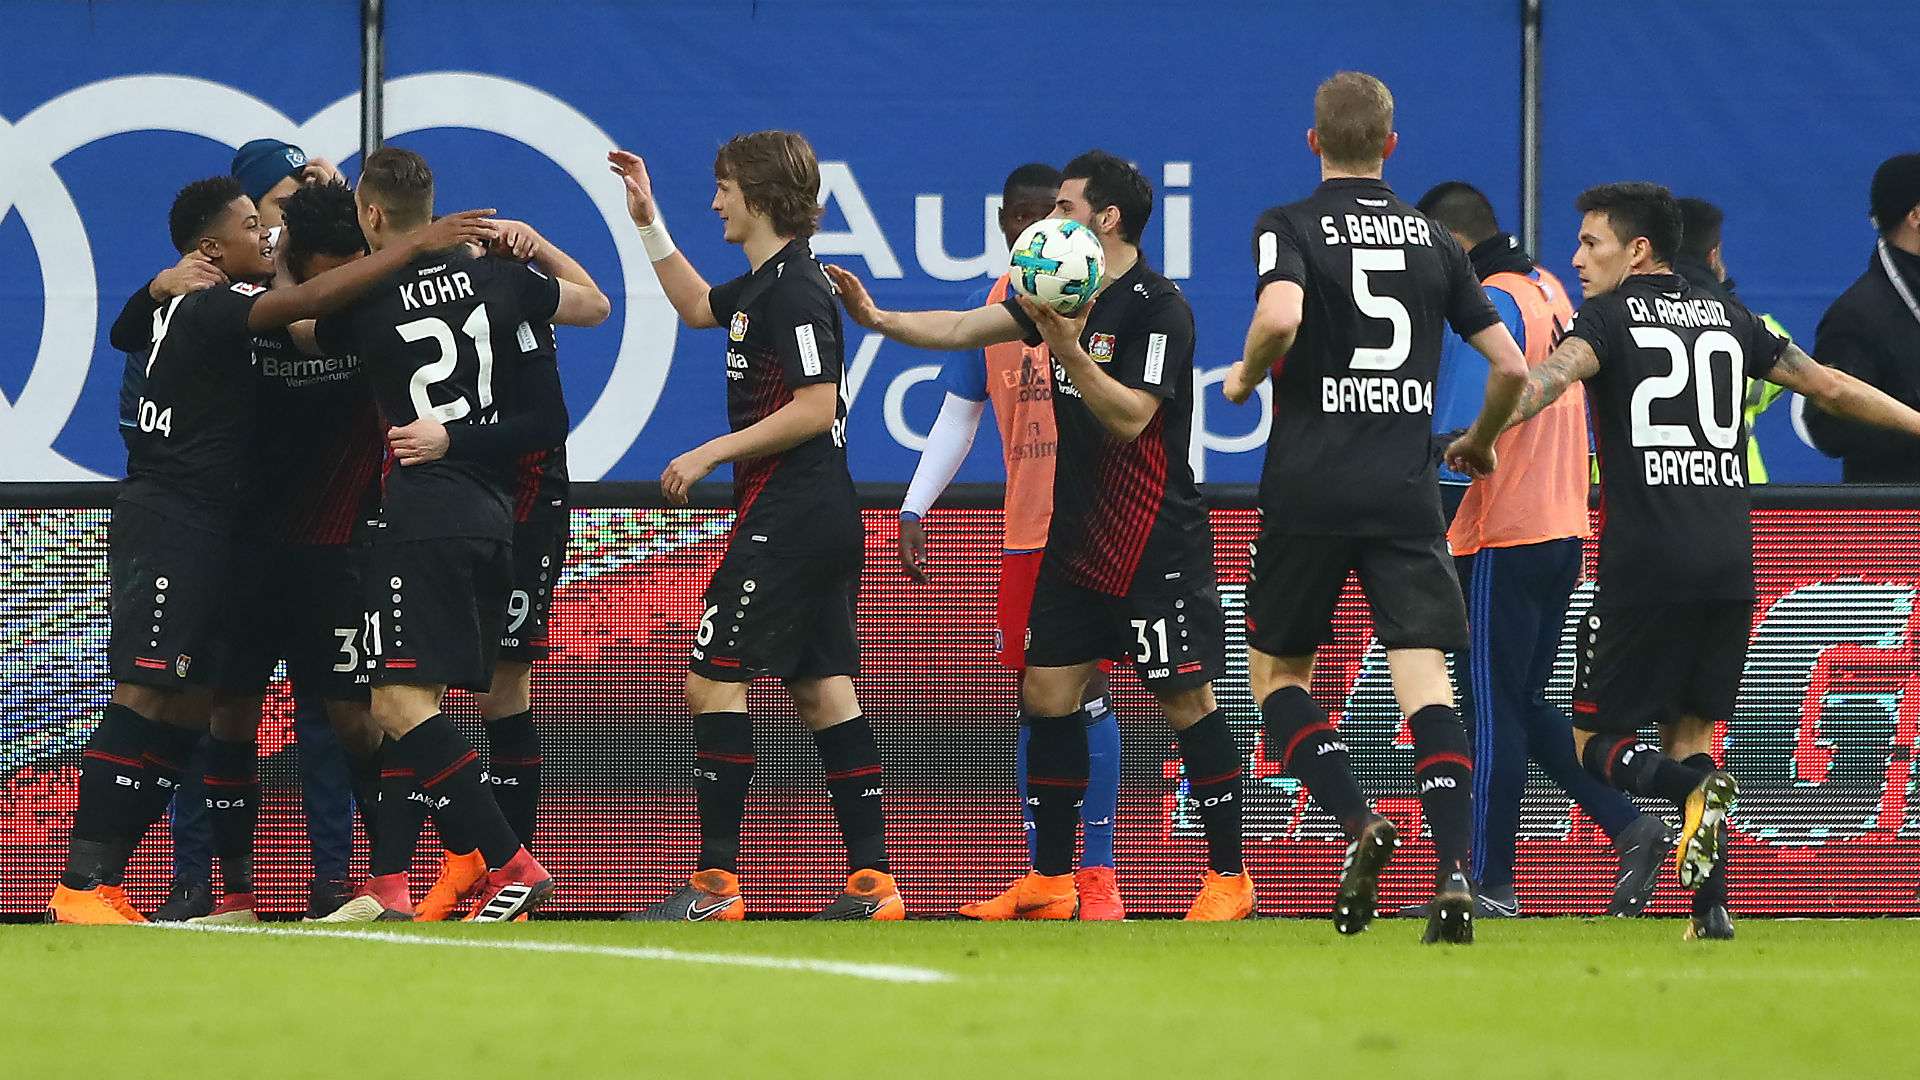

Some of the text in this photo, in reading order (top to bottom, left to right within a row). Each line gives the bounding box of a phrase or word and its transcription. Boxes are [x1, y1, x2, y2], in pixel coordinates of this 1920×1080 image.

[808, 161, 1193, 282] Aui
[399, 271, 475, 311] KOHR
[1348, 248, 1413, 371] 5
[395, 302, 494, 425] 21
[1322, 377, 1400, 413] BAYER
[1628, 326, 1745, 449] 20
[1644, 450, 1719, 486] BAYER
[1130, 618, 1169, 663] 31
